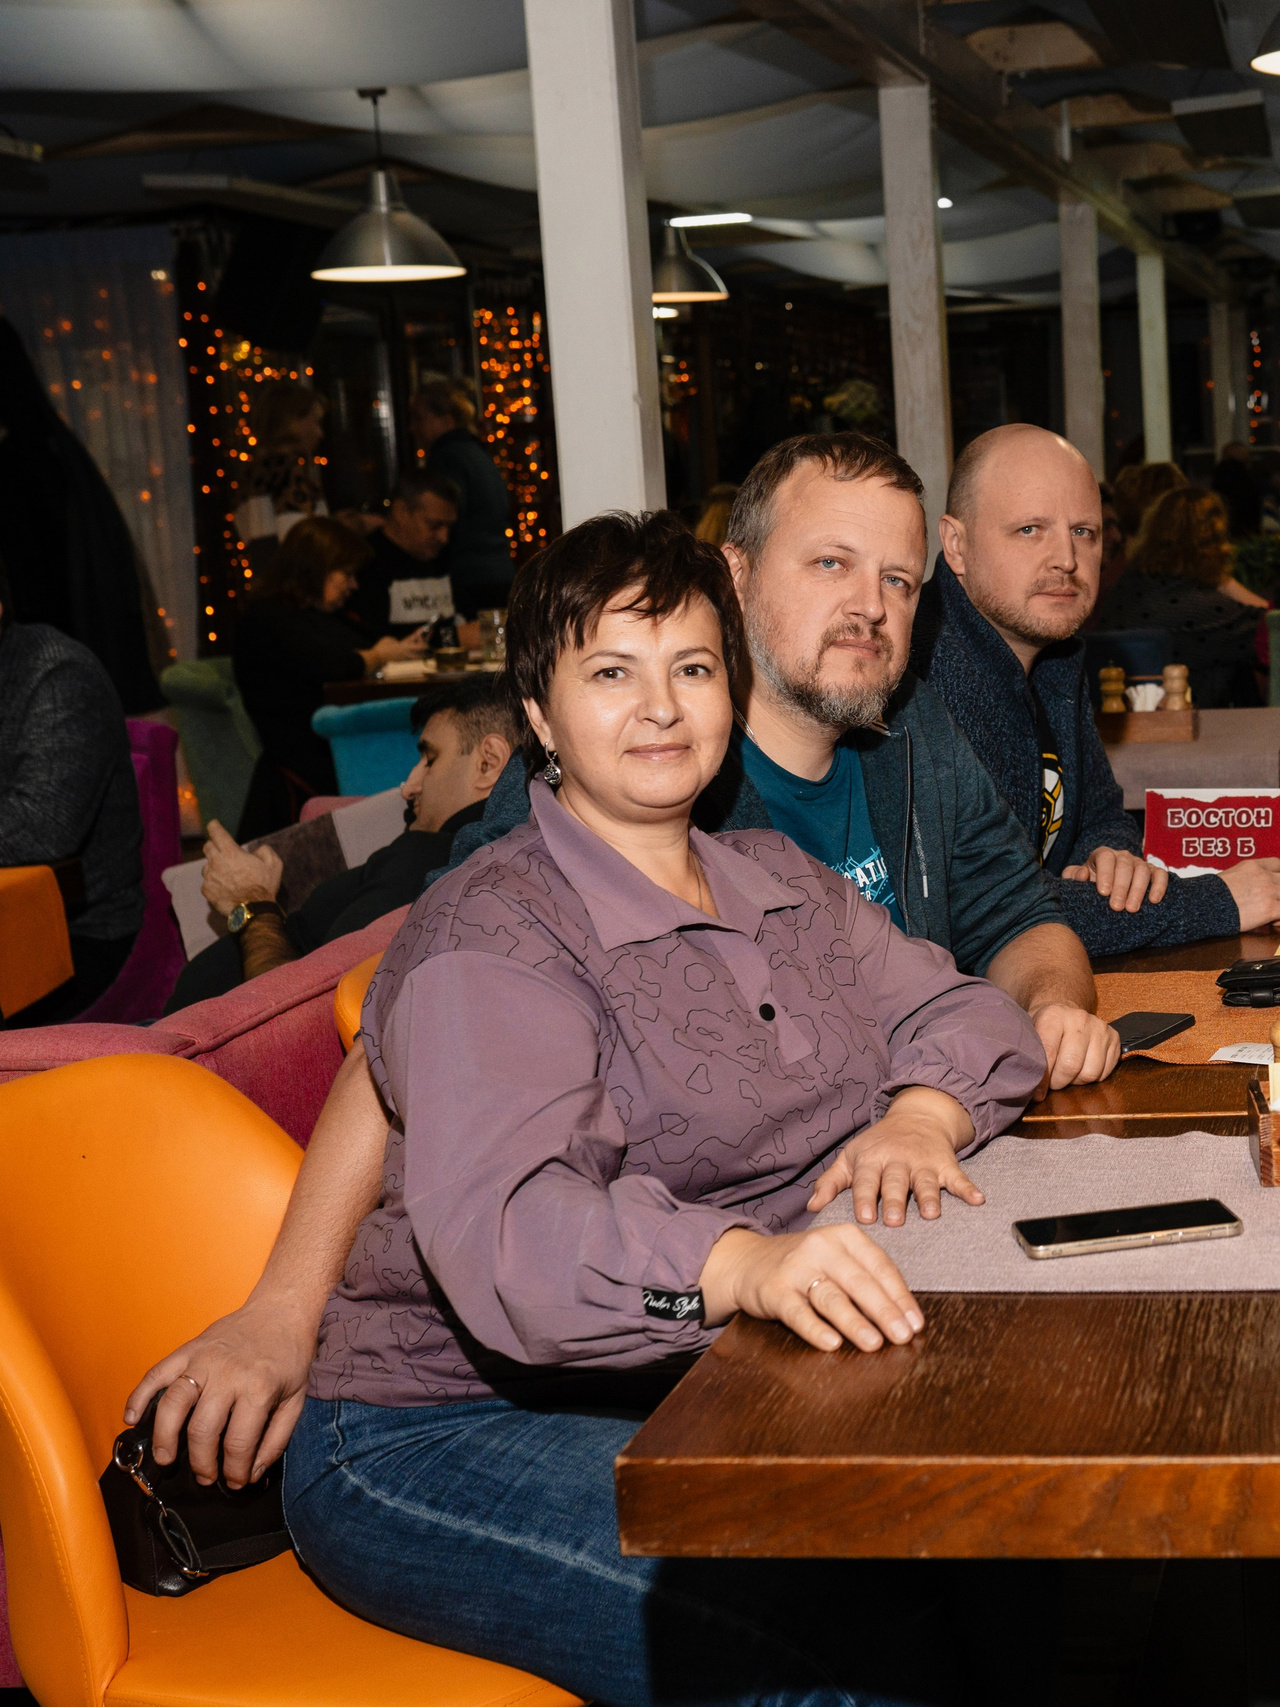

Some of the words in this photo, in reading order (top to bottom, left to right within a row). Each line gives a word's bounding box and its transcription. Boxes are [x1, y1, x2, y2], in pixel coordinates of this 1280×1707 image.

[1167, 807, 1272, 828] БОСТОН
[1182, 837, 1231, 857] БЕЗ
[1237, 837, 1255, 857] Б
[672, 1295, 701, 1319] Style
